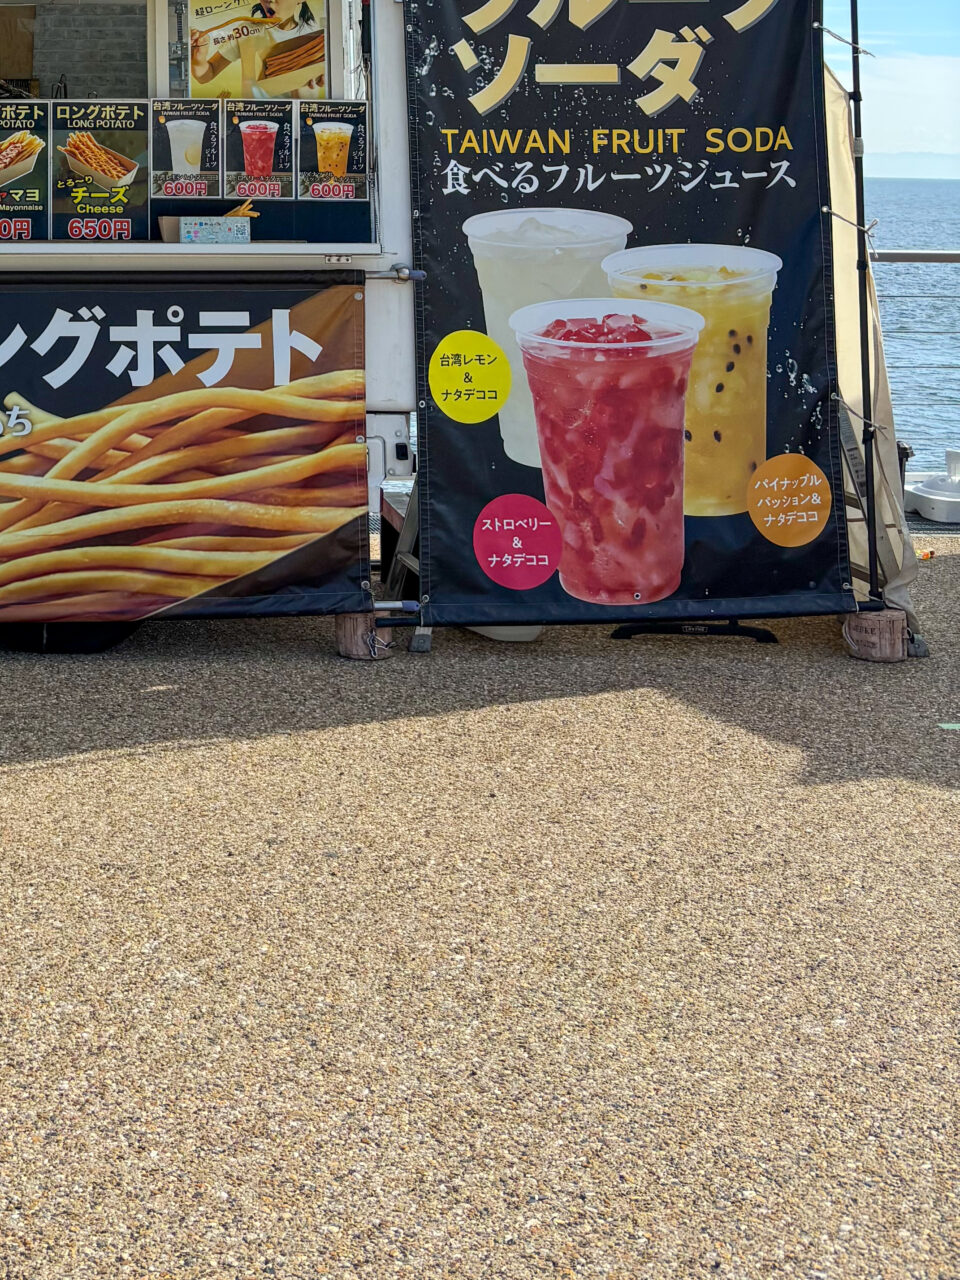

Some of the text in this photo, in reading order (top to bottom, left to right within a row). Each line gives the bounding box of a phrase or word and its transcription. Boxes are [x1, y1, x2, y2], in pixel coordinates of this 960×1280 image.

[452, 24, 714, 116] ソーダ
[56, 105, 144, 119] ロングポテト
[153, 101, 218, 111] 台湾フルーツソーダ
[227, 102, 292, 112] 台湾フルーツソーダ
[300, 103, 366, 113] 台湾フルーツソーダ
[67, 119, 135, 128] LONG POTATO
[441, 126, 793, 154] TAIWAN FRUIT SODA
[441, 159, 797, 195] 食べるフルーツジュース
[70, 185, 130, 204] チーズ
[164, 181, 207, 196] 600円
[237, 182, 280, 197] 600円
[310, 183, 355, 198] 600円
[76, 204, 124, 214] Cheese
[68, 218, 131, 239] 650円
[439, 352, 498, 368] 台湾レモン
[463, 372, 473, 384] &
[440, 388, 498, 402] ナタデココ
[754, 473, 822, 489] パイナップル
[757, 492, 822, 508] パッション&
[481, 516, 552, 532] ストロベリー
[763, 510, 819, 525] ナタデココ
[512, 537, 522, 549] &
[488, 552, 550, 568] ナタデココ
